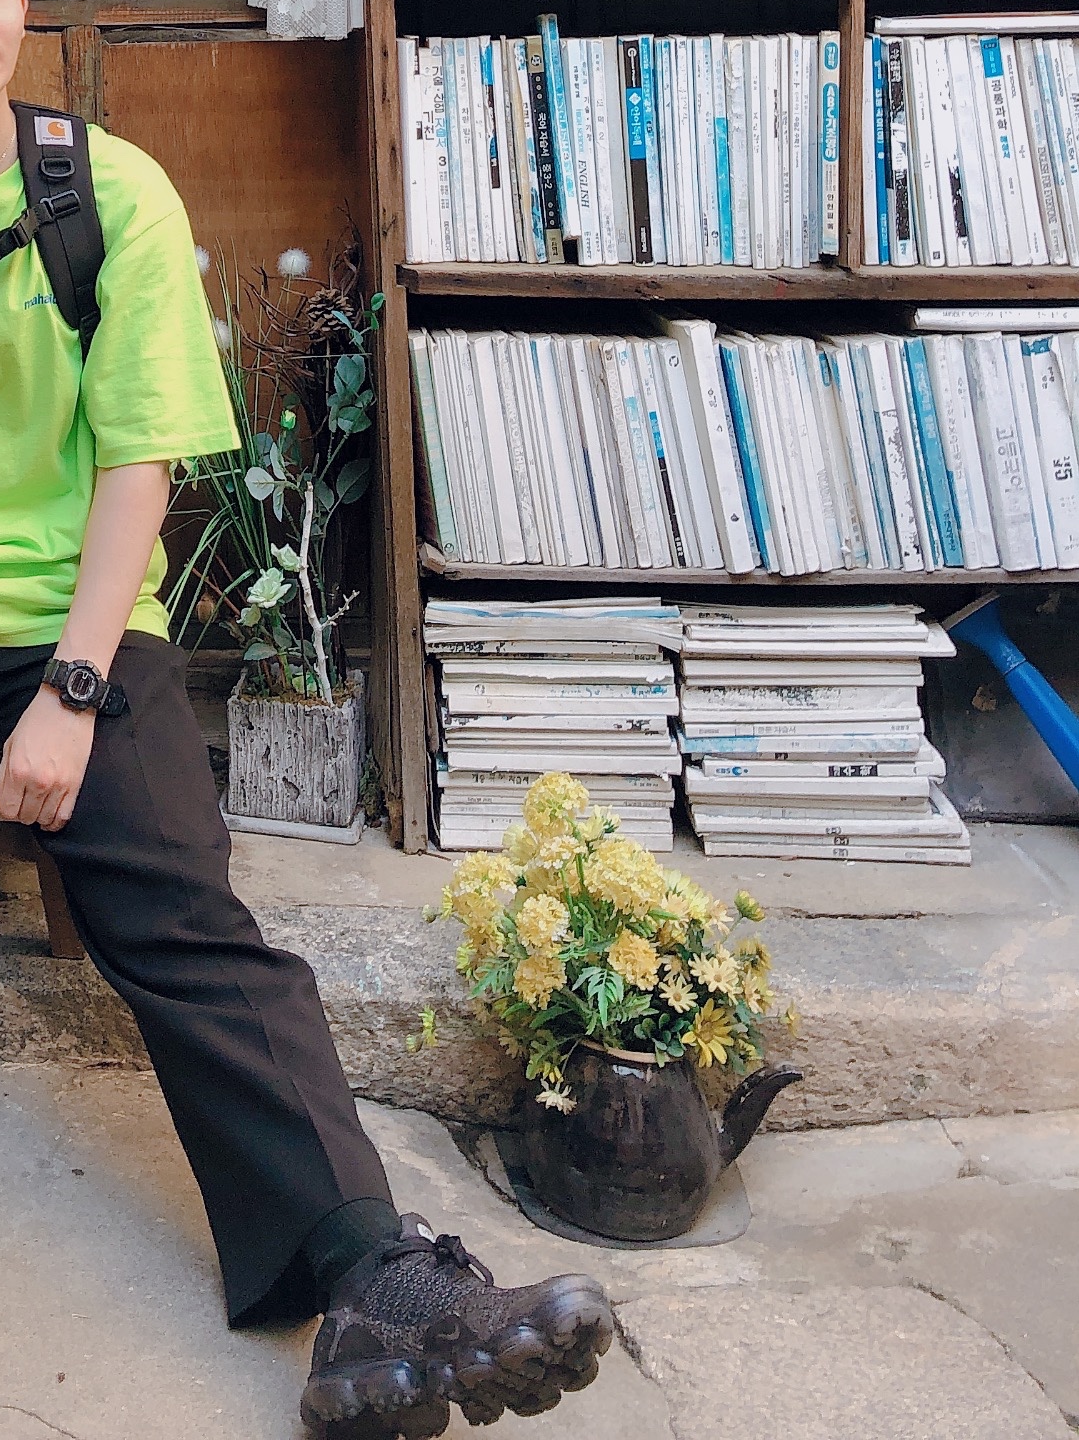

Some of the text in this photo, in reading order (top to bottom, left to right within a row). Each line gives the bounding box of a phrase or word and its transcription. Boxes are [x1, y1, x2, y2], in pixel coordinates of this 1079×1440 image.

[539, 131, 551, 157] 자습서
[438, 155, 447, 166] 3
[578, 159, 591, 209] ENGLISH
